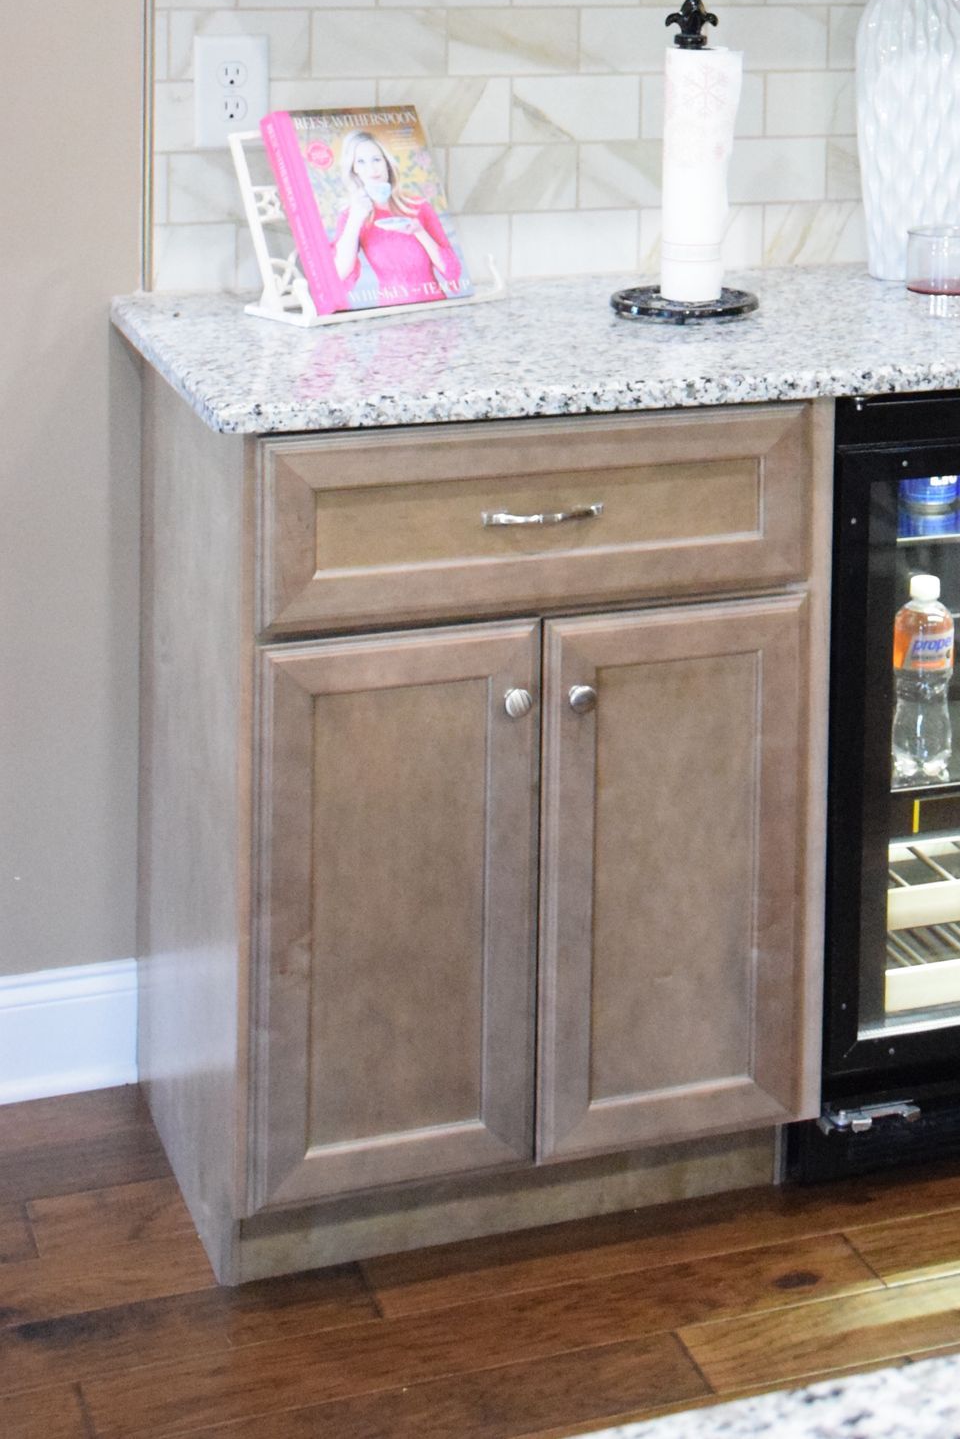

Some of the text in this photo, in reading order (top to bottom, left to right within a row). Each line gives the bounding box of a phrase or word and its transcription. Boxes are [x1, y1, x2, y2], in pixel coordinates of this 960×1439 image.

[293, 110, 417, 131] REESE WITHERSPOON
[348, 282, 409, 302] WHISKEY
